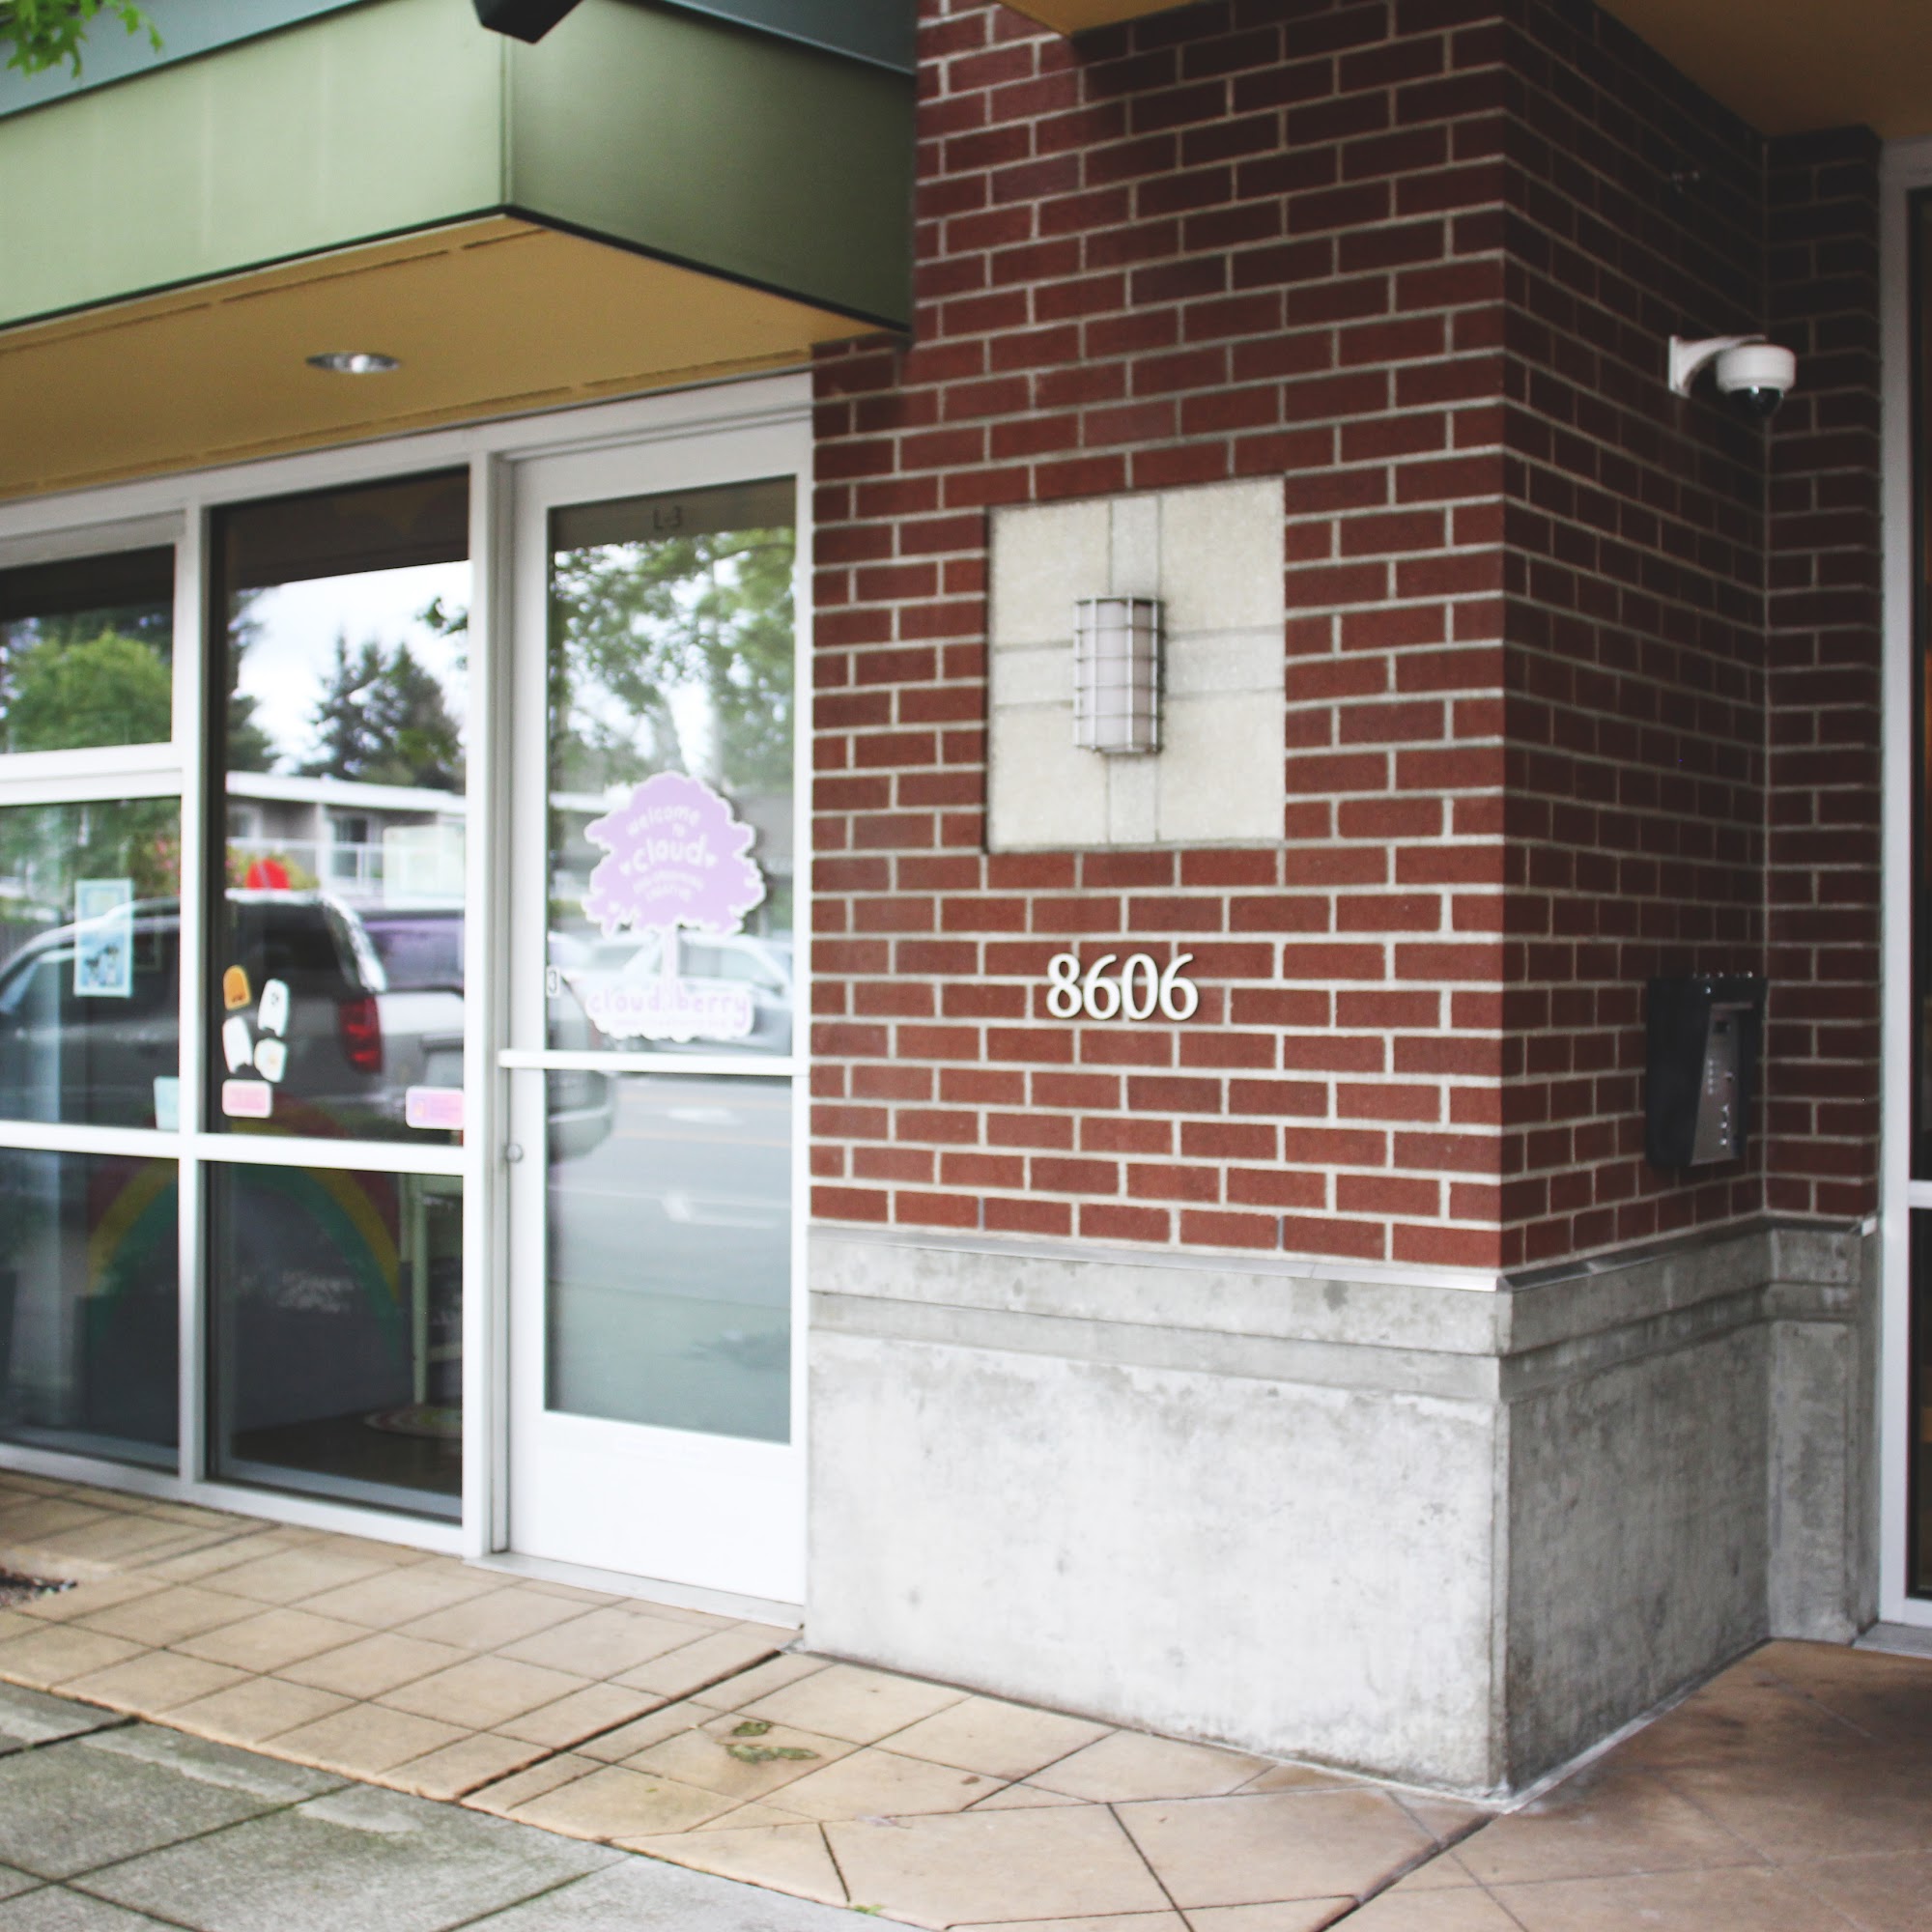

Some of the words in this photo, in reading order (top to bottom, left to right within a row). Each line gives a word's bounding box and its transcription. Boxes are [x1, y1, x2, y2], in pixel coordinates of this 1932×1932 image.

[626, 805, 701, 838] welcome
[633, 833, 709, 873] cloud
[1046, 952, 1199, 1021] 8606
